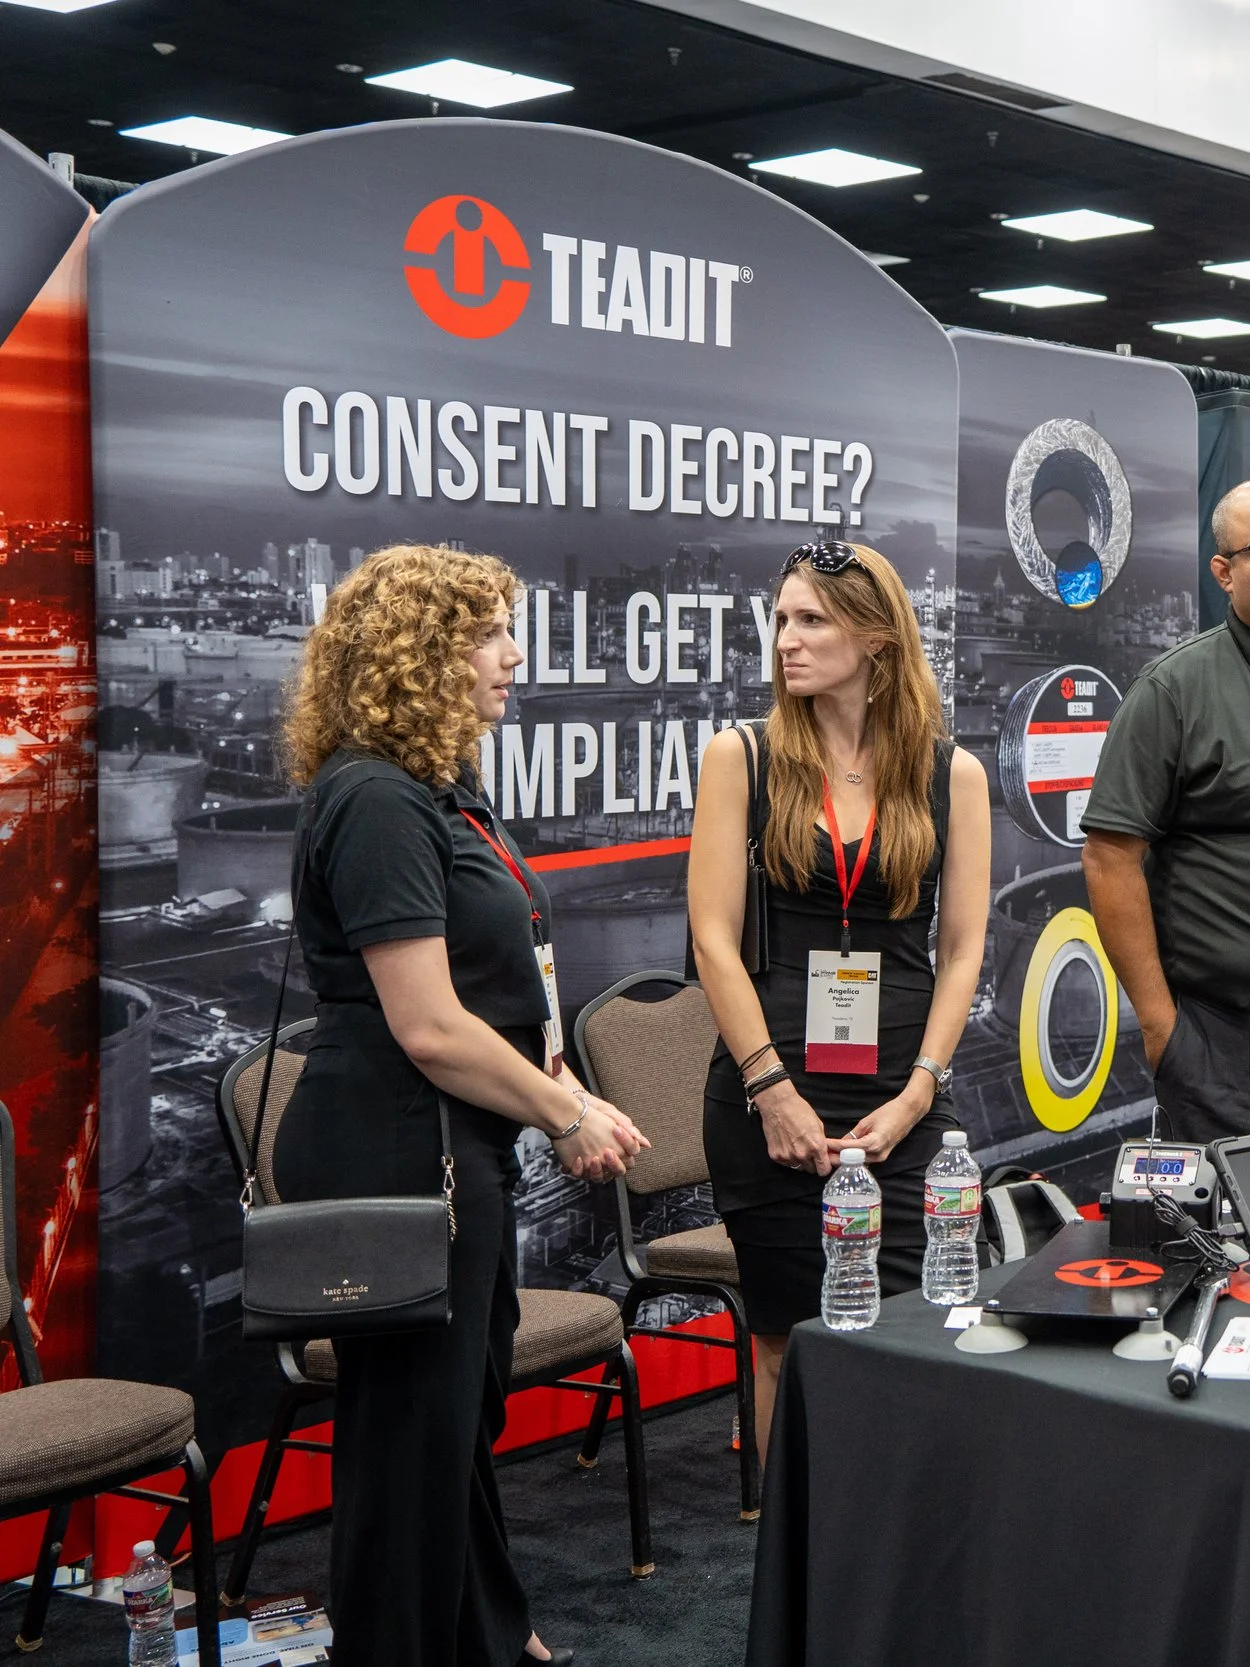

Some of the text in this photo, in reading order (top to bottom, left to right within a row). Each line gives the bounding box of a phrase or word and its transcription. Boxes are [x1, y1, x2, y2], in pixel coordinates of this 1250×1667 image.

[283, 386, 874, 526] CONSENT DECREE?
[514, 589, 606, 684] ILL
[625, 591, 734, 684] GET
[1075, 681, 1098, 696] TEADIT
[1073, 704, 1088, 713] 2236
[828, 988, 860, 996] Angelica
[323, 1285, 369, 1296] kate spade
[287, 1604, 307, 1613] Our
